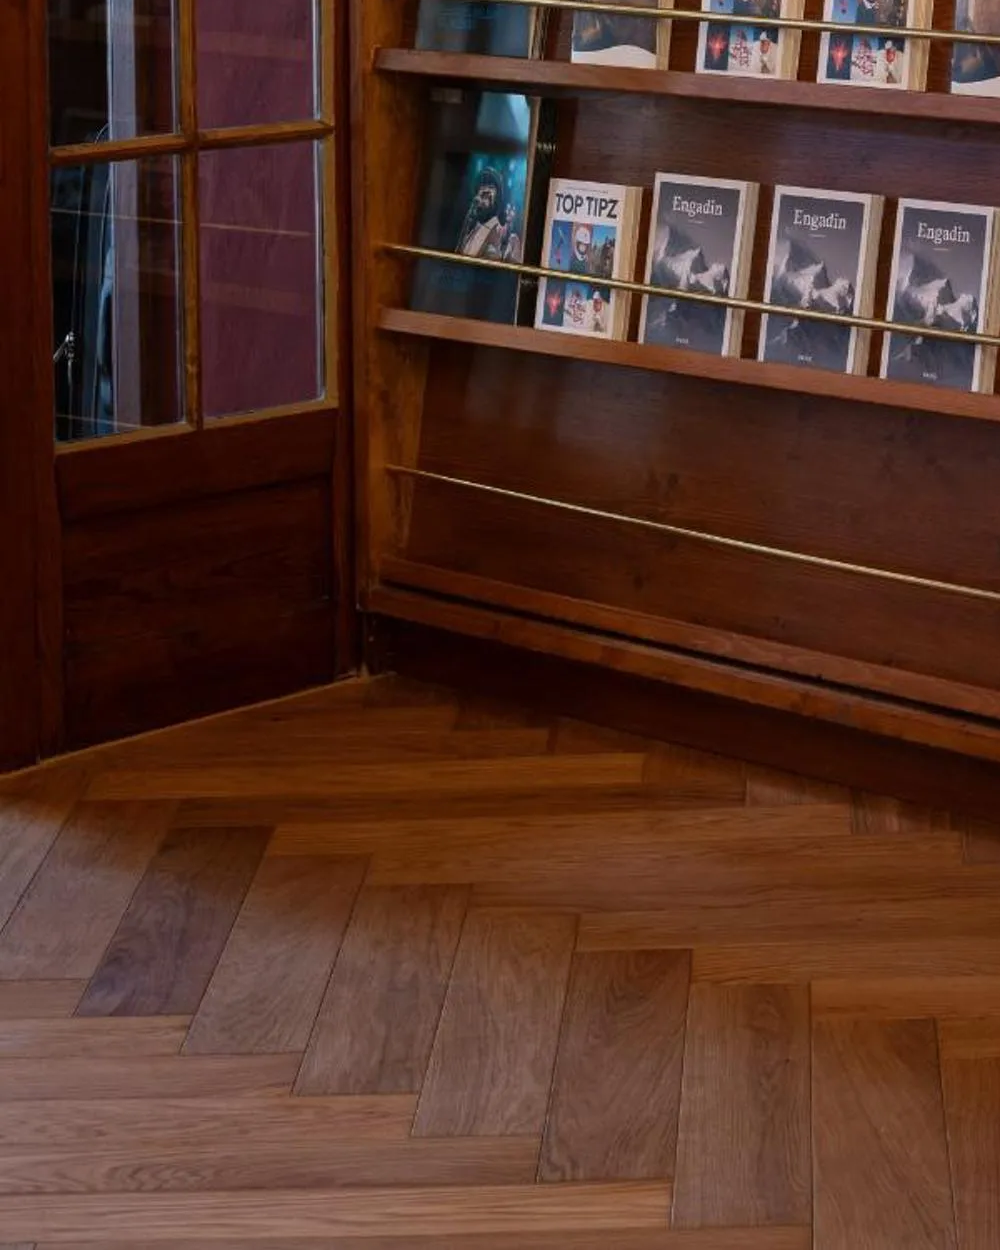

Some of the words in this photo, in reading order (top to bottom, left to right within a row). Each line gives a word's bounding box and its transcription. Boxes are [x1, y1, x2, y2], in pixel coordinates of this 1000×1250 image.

[556, 193, 583, 214] TOP
[586, 196, 619, 219] TIPZ
[671, 195, 724, 218] Engadin
[792, 209, 847, 230] Engadin
[917, 221, 971, 244] Engadin
